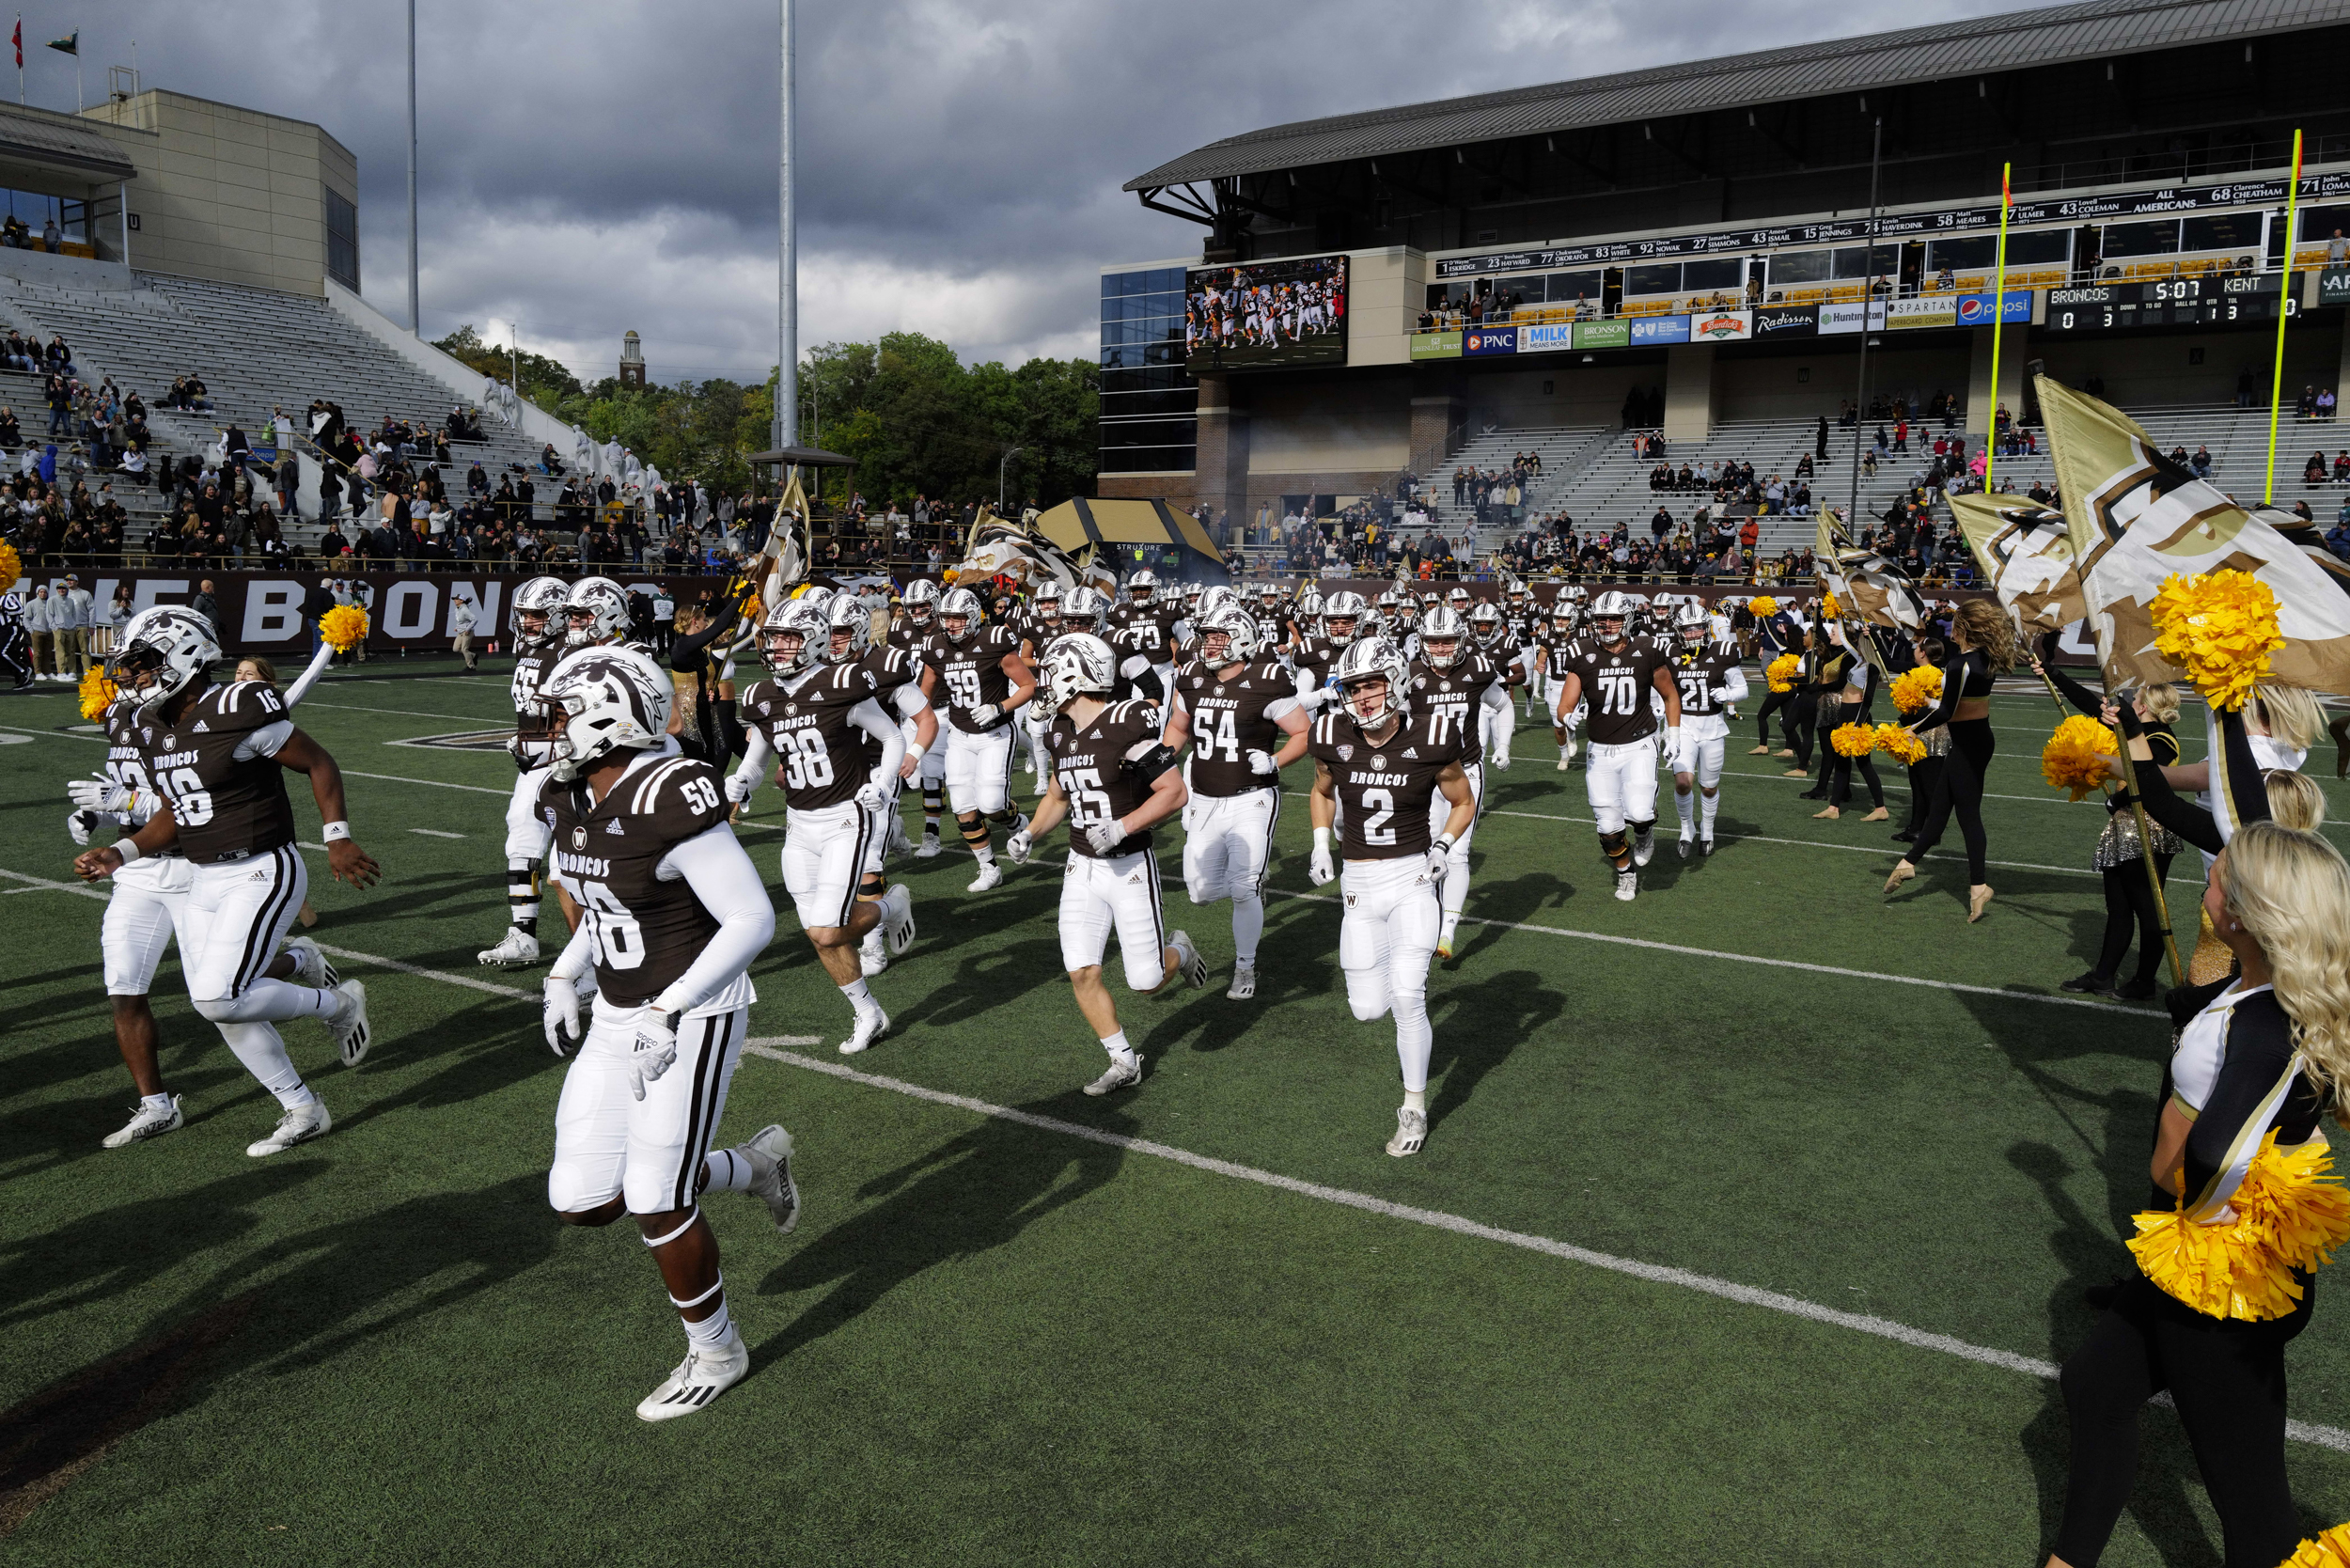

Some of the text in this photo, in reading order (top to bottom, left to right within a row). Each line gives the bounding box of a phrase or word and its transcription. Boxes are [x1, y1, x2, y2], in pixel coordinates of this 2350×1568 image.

[2233, 182, 2265, 191] Clarence
[2301, 180, 2319, 193] 71
[2155, 190, 2174, 200] ALL
[2211, 188, 2231, 202] 68
[2232, 188, 2282, 199] CHEATHAM
[2059, 203, 2076, 215] 43
[2078, 203, 2120, 213] COLEMAN
[2133, 199, 2197, 213] AMERICANS
[130, 215, 138, 228] U
[1936, 215, 1953, 227] 58
[1955, 215, 1986, 225] MEARES
[2018, 211, 2044, 219] ULMER
[1819, 228, 1853, 238] JENNINGS
[1882, 222, 1923, 231] HAVERDINK
[1751, 233, 1766, 243] 43
[1803, 228, 1817, 239] 15
[1640, 243, 1653, 254] 92
[1655, 244, 1681, 253] NOWAK
[1693, 239, 1707, 249] 27
[1708, 240, 1740, 248] SIMMONS
[1541, 254, 1554, 264] 77
[1555, 254, 1589, 262] OKORAFOR
[1595, 248, 1609, 259] 83
[1442, 263, 1448, 273] 1
[1487, 259, 1500, 268] 23
[1501, 259, 1530, 267] HAYWARD
[2155, 281, 2200, 300] 5:07
[2224, 277, 2261, 292] KENT
[2051, 288, 2109, 304] BRONCOS
[1898, 300, 1956, 314] SPARTAN
[1983, 299, 2028, 317] pepsi
[2228, 306, 2237, 320] 3
[2284, 299, 2296, 317] 0
[1833, 311, 1883, 322] Huntinton
[2062, 312, 2074, 329] 0
[2104, 314, 2113, 327] 3
[2212, 308, 2217, 320] 1
[1757, 312, 1813, 335] Radisson
[1888, 316, 1954, 326] PAPERBOARD COMPANY
[1530, 326, 1568, 342] MILK
[1584, 324, 1626, 335] BRONSON
[1482, 335, 1513, 348] PNC
[1412, 344, 1441, 353] GREENLEAF
[1117, 543, 1161, 552] STRUXURE
[1129, 619, 1156, 628] BRONCOS
[1259, 623, 1278, 643] 36
[945, 661, 977, 672] BRONCOS
[1598, 666, 1636, 677] BRONCOS
[1677, 670, 1710, 679] BRONCOS
[944, 669, 982, 709] 59
[1598, 676, 1637, 715] 70
[1680, 679, 1710, 712] 21
[256, 688, 281, 713] 16
[1198, 698, 1239, 710] BRONCOS
[1426, 692, 1467, 705] BRONCOS
[773, 713, 818, 734] BRONCOS
[1140, 708, 1160, 729] 35
[1194, 707, 1239, 762] 54
[108, 746, 140, 760] BRONCO
[154, 749, 199, 770] BRONCOS
[773, 728, 835, 790] 38
[1058, 754, 1095, 770] BRONCOS
[1349, 771, 1409, 787] BRONCOS
[156, 767, 214, 827] 16
[680, 776, 720, 816] 58
[1058, 768, 1114, 829] 35
[1361, 788, 1397, 845] 2
[606, 827, 625, 836] adidas
[558, 851, 611, 878] BRONCOS
[636, 1030, 658, 1048] adidas
[281, 1122, 321, 1149] ADIZERO
